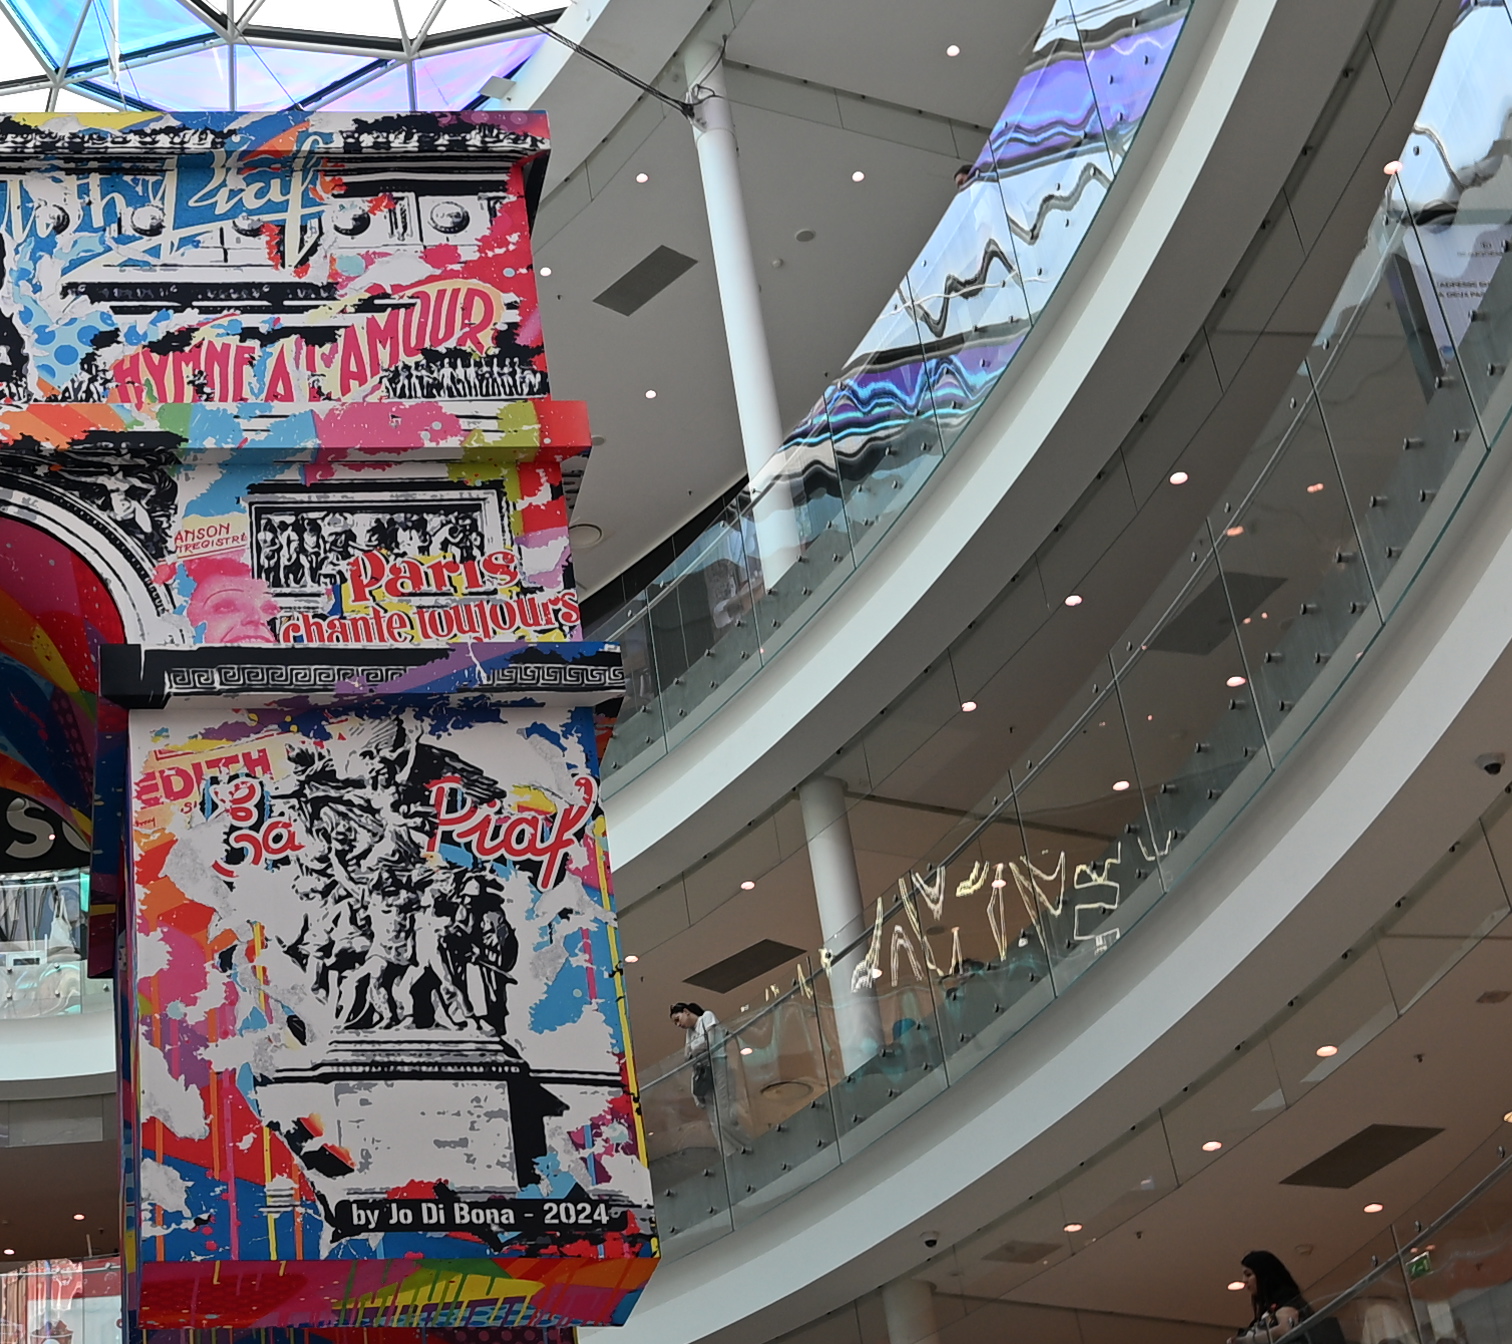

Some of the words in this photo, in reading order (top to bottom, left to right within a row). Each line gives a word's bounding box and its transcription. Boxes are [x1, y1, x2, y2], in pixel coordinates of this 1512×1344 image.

[112, 340, 256, 410] HYMNE
[174, 522, 231, 545] ANSON
[349, 551, 520, 604] Paris
[282, 609, 413, 643] chante
[417, 592, 581, 643] toujours
[133, 748, 275, 810] EDITH
[425, 775, 597, 892] Piaf
[351, 1203, 378, 1229] by
[389, 1202, 413, 1225] Jo
[422, 1202, 446, 1225] Di
[454, 1202, 515, 1225] Bona
[543, 1202, 610, 1225] 2024
